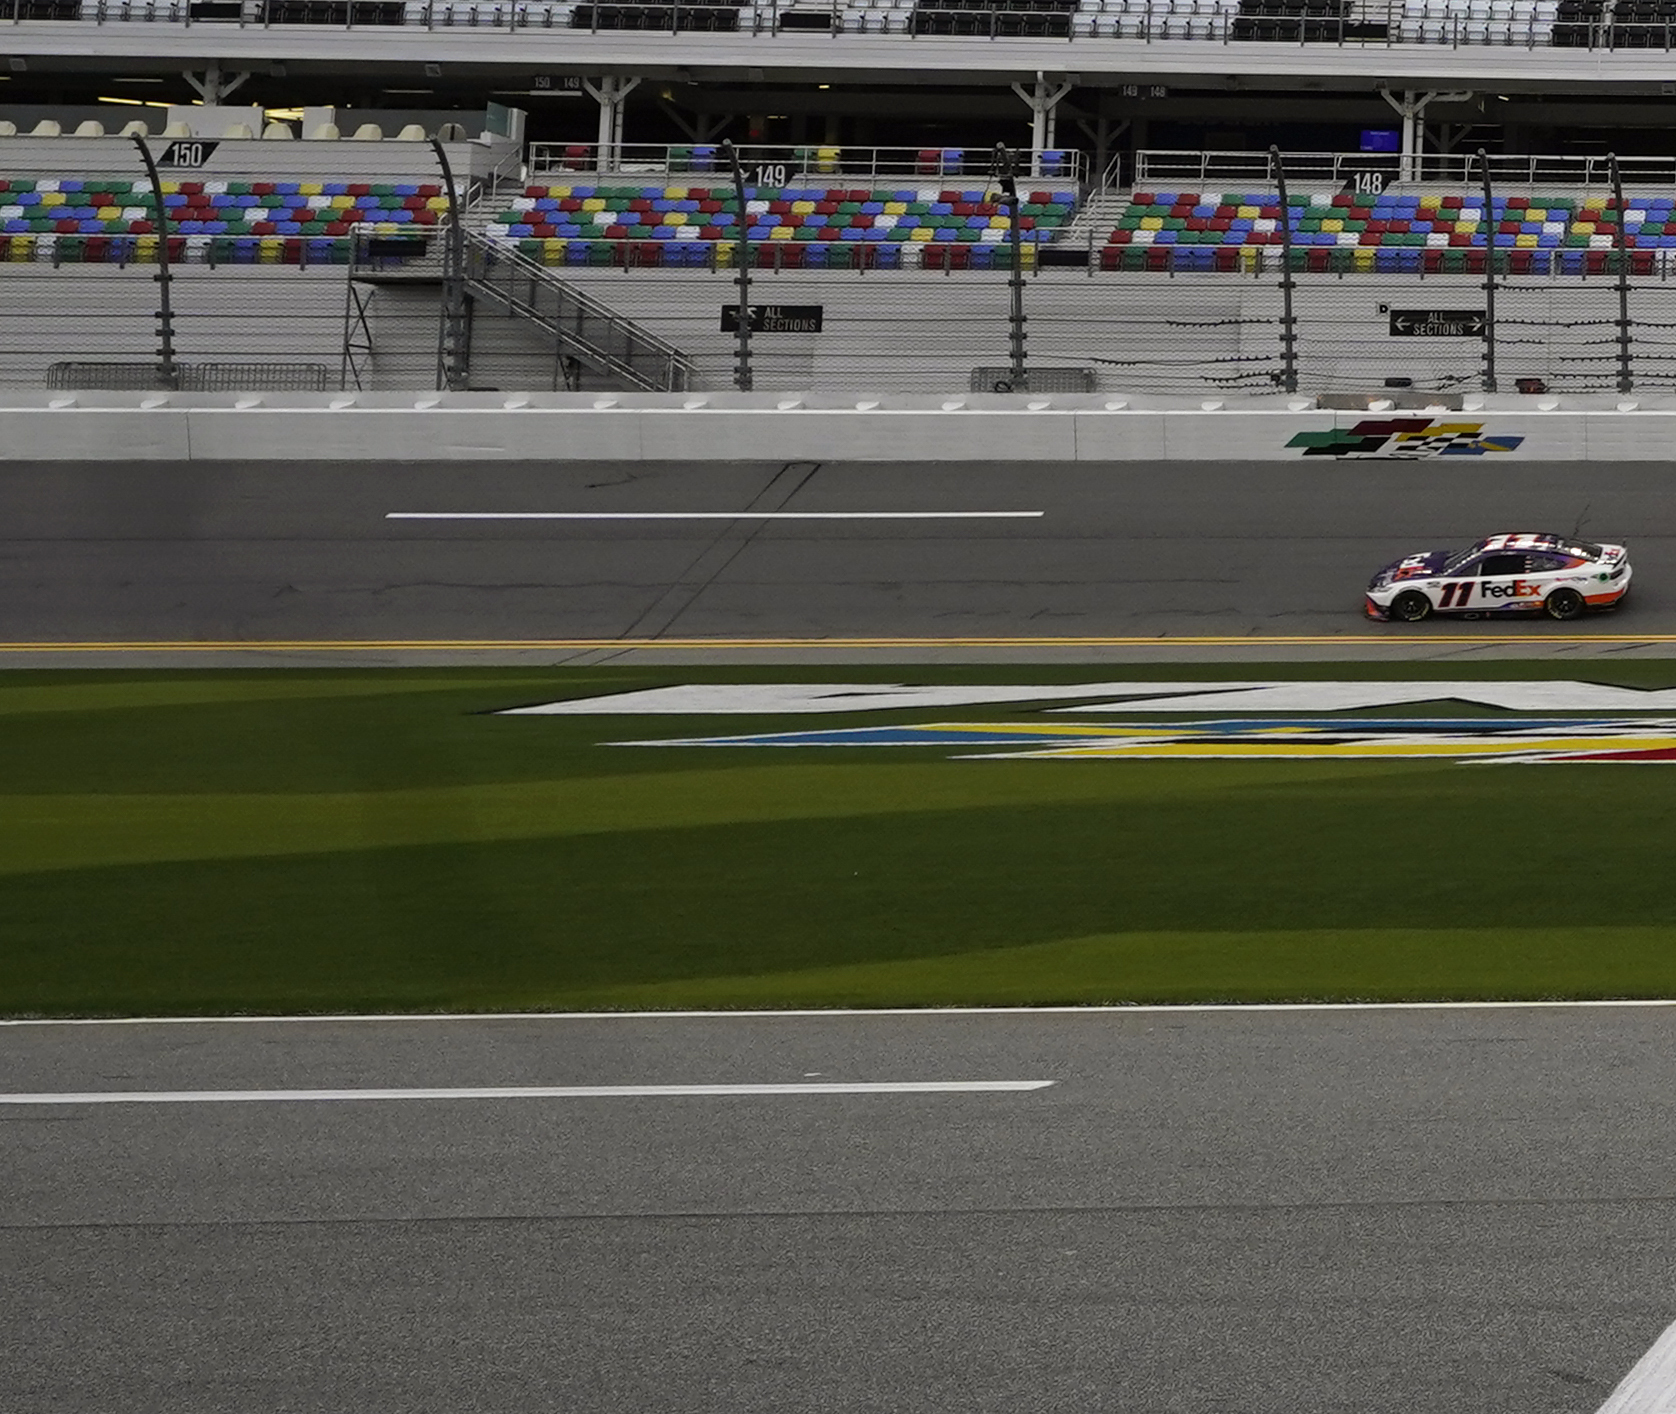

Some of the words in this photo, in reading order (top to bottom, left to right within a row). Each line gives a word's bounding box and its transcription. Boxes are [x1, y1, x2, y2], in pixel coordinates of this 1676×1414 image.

[172, 143, 202, 167] 150
[756, 164, 786, 188] 149
[1353, 172, 1382, 195] 148
[764, 306, 783, 318] ALL
[1427, 311, 1446, 323] ALL
[763, 318, 816, 331] SECTIONS
[1413, 323, 1464, 336] SECTIONS
[1437, 581, 1475, 608] 11
[1480, 579, 1543, 599] FedEx
